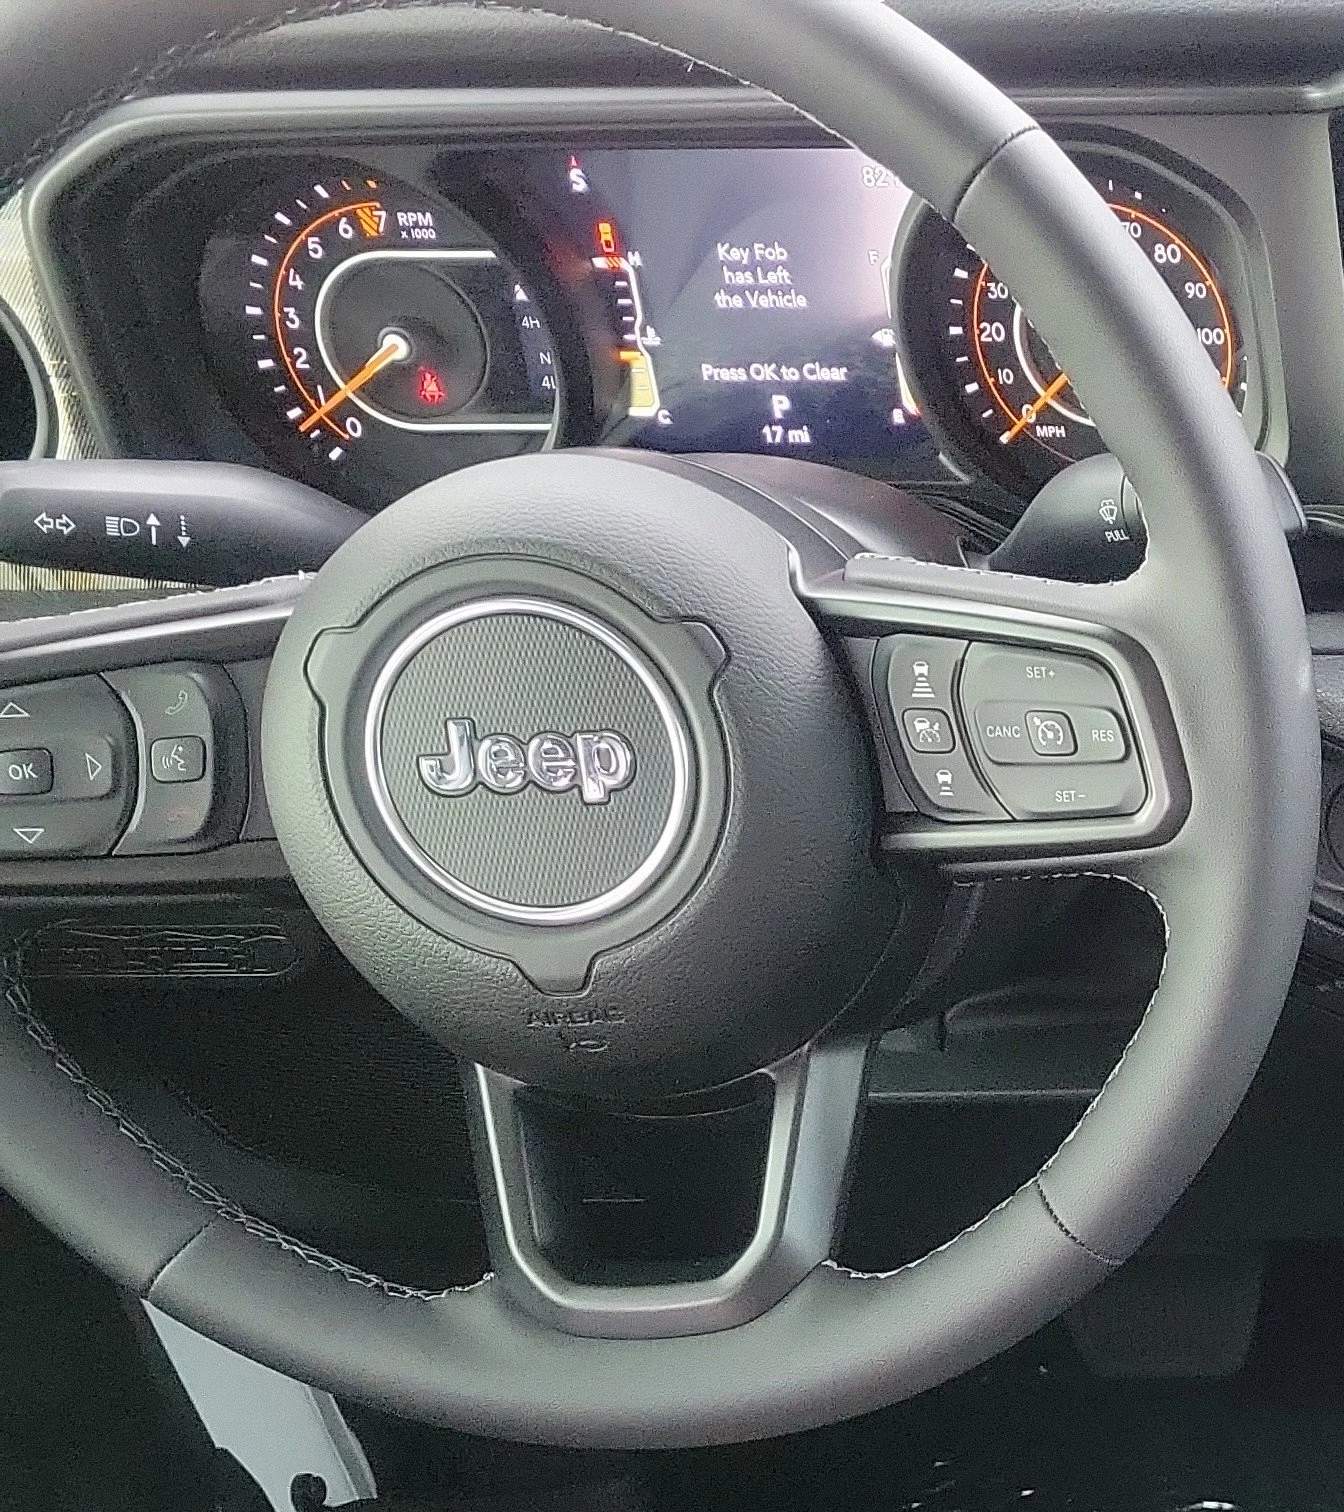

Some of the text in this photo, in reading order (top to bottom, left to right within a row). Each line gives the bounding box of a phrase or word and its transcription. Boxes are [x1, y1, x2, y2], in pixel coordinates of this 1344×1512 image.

[569, 168, 588, 192] S
[338, 216, 353, 238] 6
[373, 210, 387, 232] 7
[397, 211, 433, 227] RPM
[400, 228, 436, 239] x 1000
[1122, 222, 1141, 238] 70
[307, 236, 323, 259] 5
[717, 241, 788, 264] Key Fob
[868, 249, 879, 265] F
[1154, 243, 1181, 263] 80
[288, 268, 303, 290] 4
[723, 265, 793, 285] has Left
[714, 289, 807, 309] the Vehicle
[986, 282, 1009, 299] 30
[1185, 281, 1207, 299] 90
[283, 306, 299, 328] 3
[521, 315, 541, 329] 4H
[979, 322, 1005, 342] 20
[1197, 327, 1225, 345] 100
[293, 347, 310, 369] 2
[539, 351, 552, 365] N
[701, 361, 848, 382] Press OK to Clear
[997, 368, 1014, 386] 10
[316, 384, 326, 406] 1
[657, 408, 673, 425] C
[771, 394, 792, 420] P
[892, 408, 906, 424] E
[345, 416, 363, 438] 0
[762, 425, 811, 444] 17 mi
[1035, 425, 1066, 438] MPH
[1104, 528, 1130, 542] PULL
[986, 725, 1021, 738] CANC
[1092, 729, 1115, 742] RES
[418, 717, 637, 805] Jeep
[8, 764, 38, 781] OK
